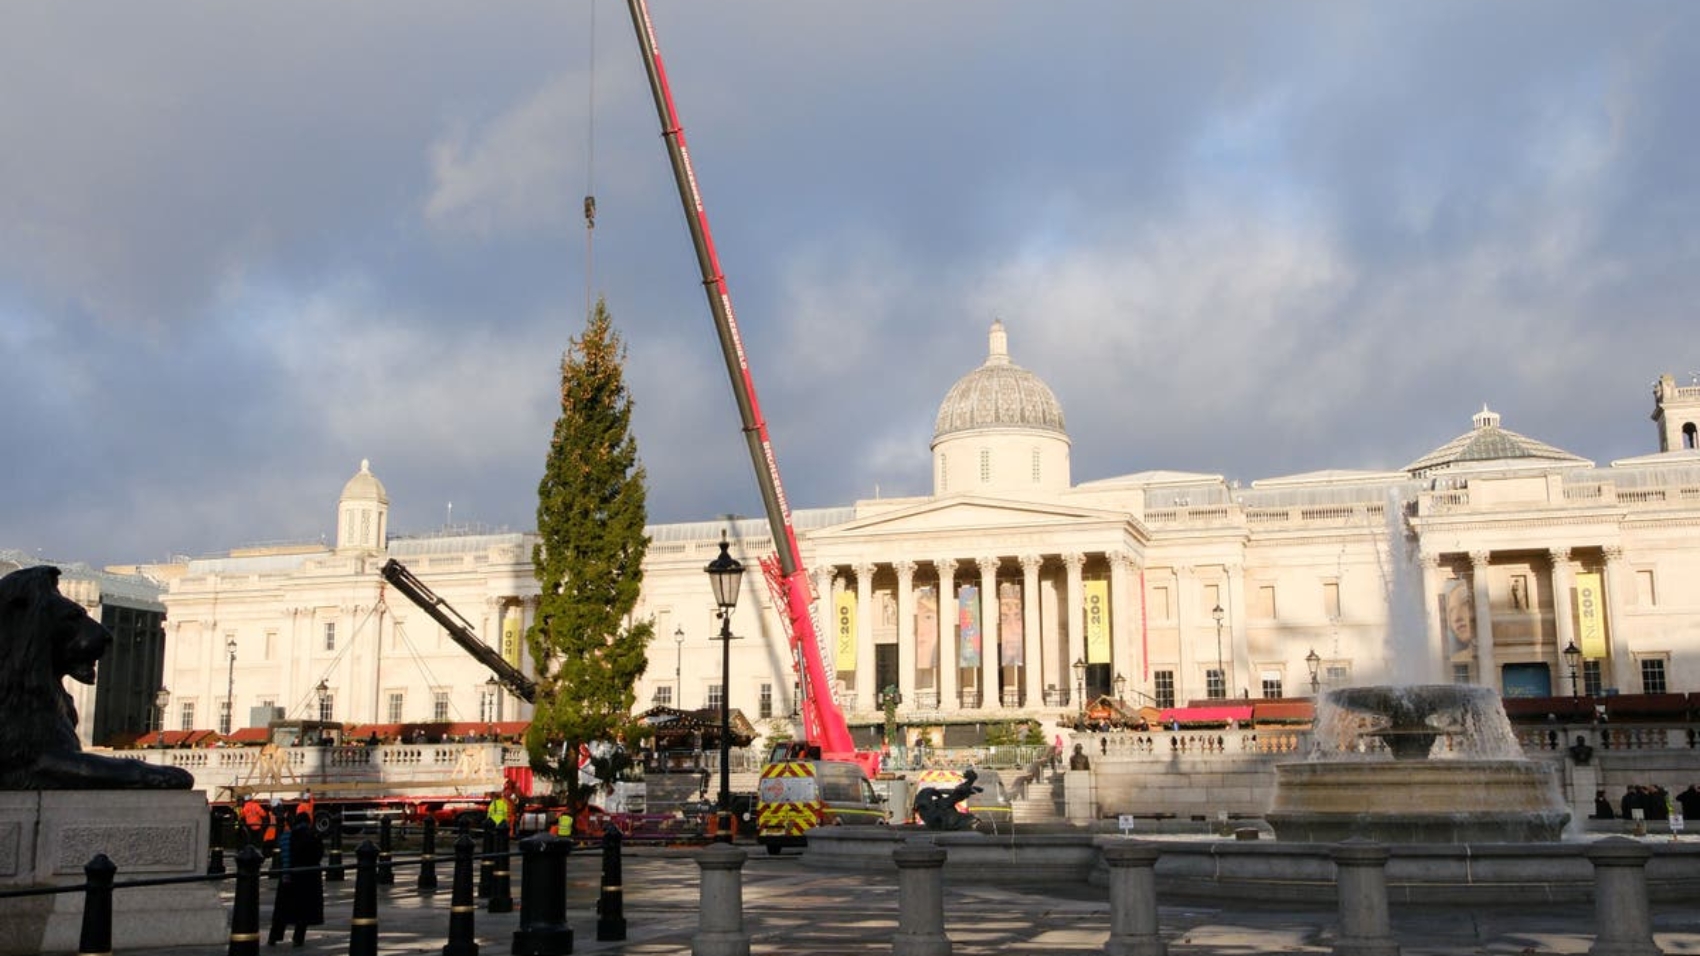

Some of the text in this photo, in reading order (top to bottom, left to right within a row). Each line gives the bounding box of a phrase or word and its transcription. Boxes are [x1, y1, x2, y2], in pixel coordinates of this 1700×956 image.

[721, 294, 747, 370] BRONZESHIELD
[762, 441, 793, 526] BRONZESHIELD
[808, 603, 839, 706] BRONZESHIELD
[840, 606, 850, 654] NG200
